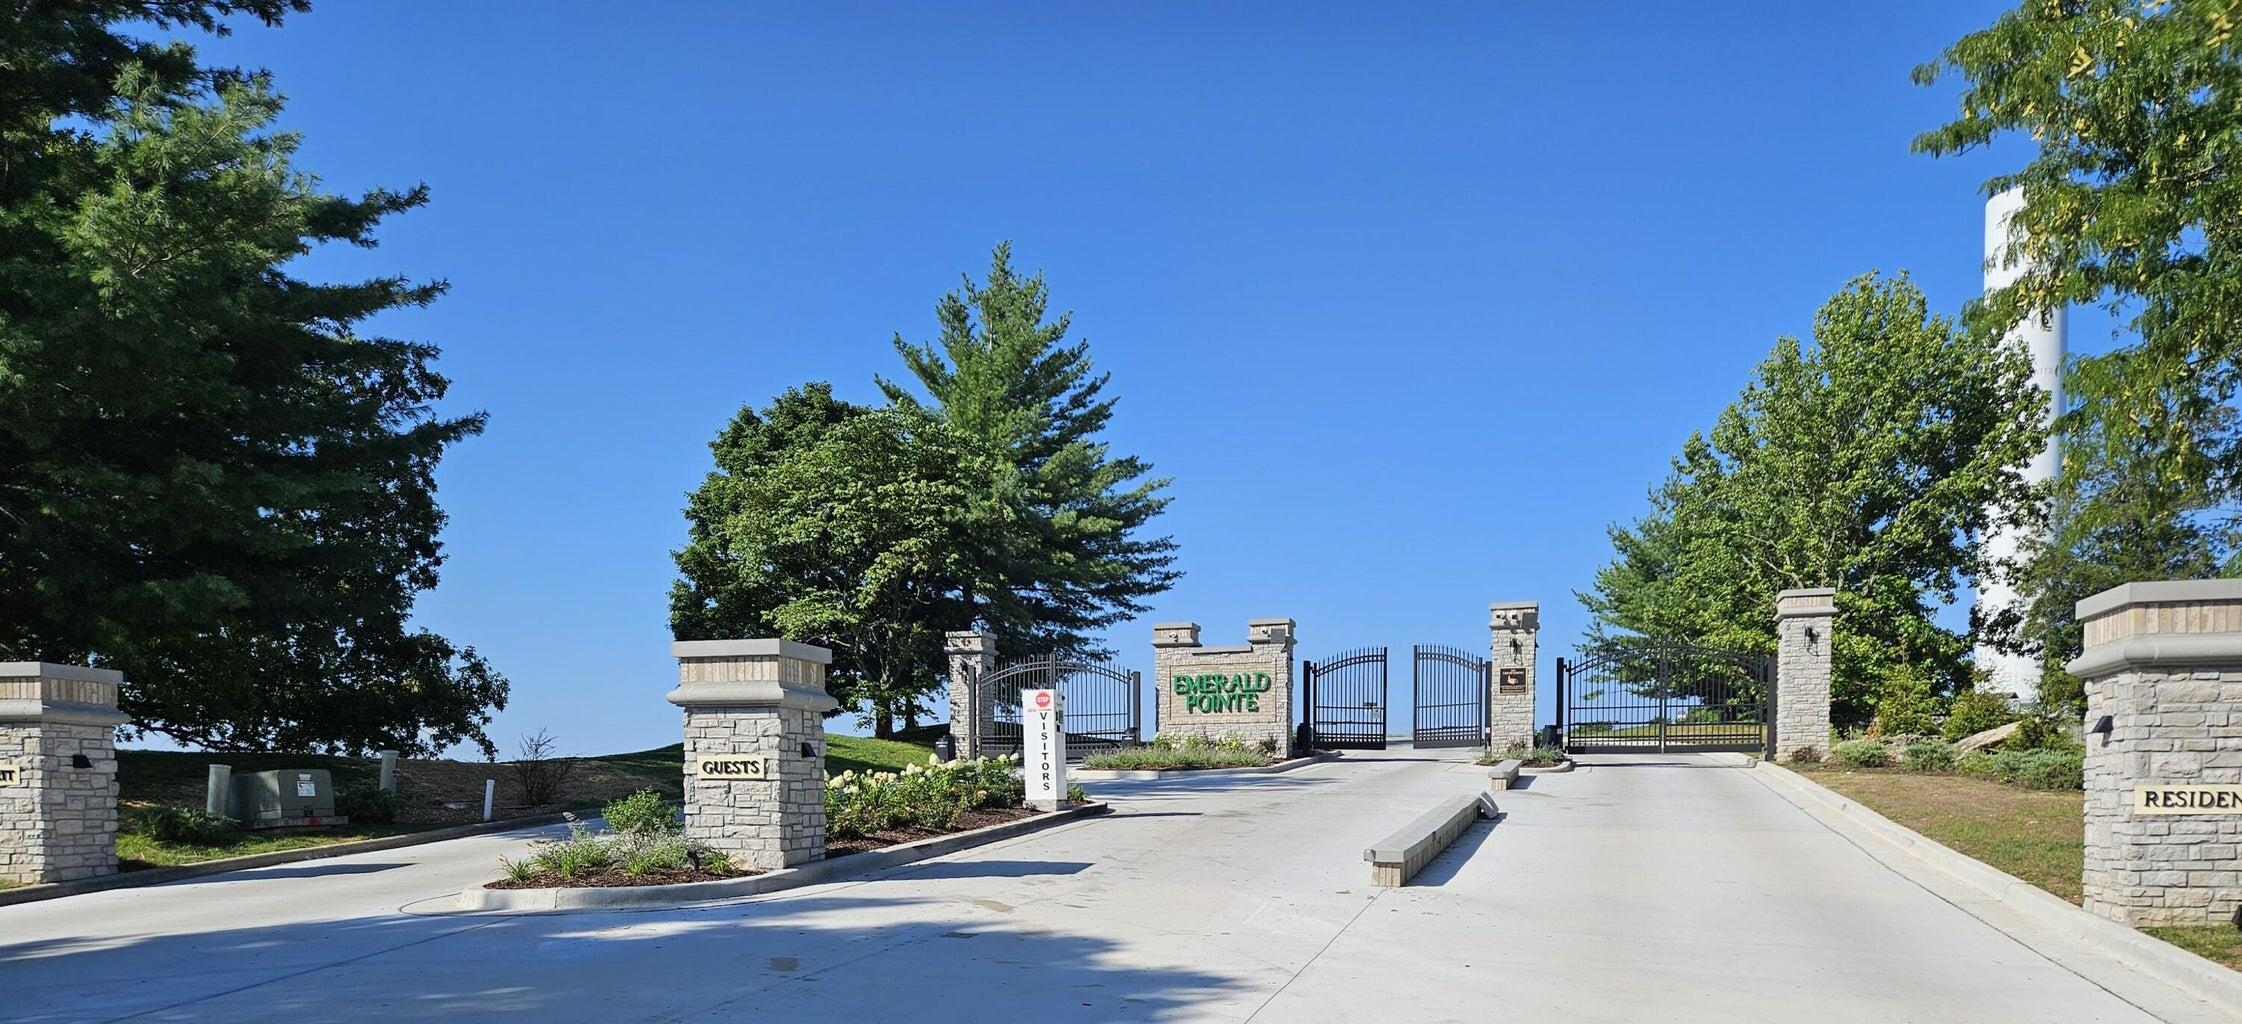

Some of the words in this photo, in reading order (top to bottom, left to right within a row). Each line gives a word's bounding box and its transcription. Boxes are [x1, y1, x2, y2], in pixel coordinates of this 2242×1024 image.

[1172, 672, 1272, 695] EMERALD
[1185, 692, 1260, 714] POINTE
[1040, 712, 1050, 791] VISITORS
[702, 761, 760, 775] GUESTS
